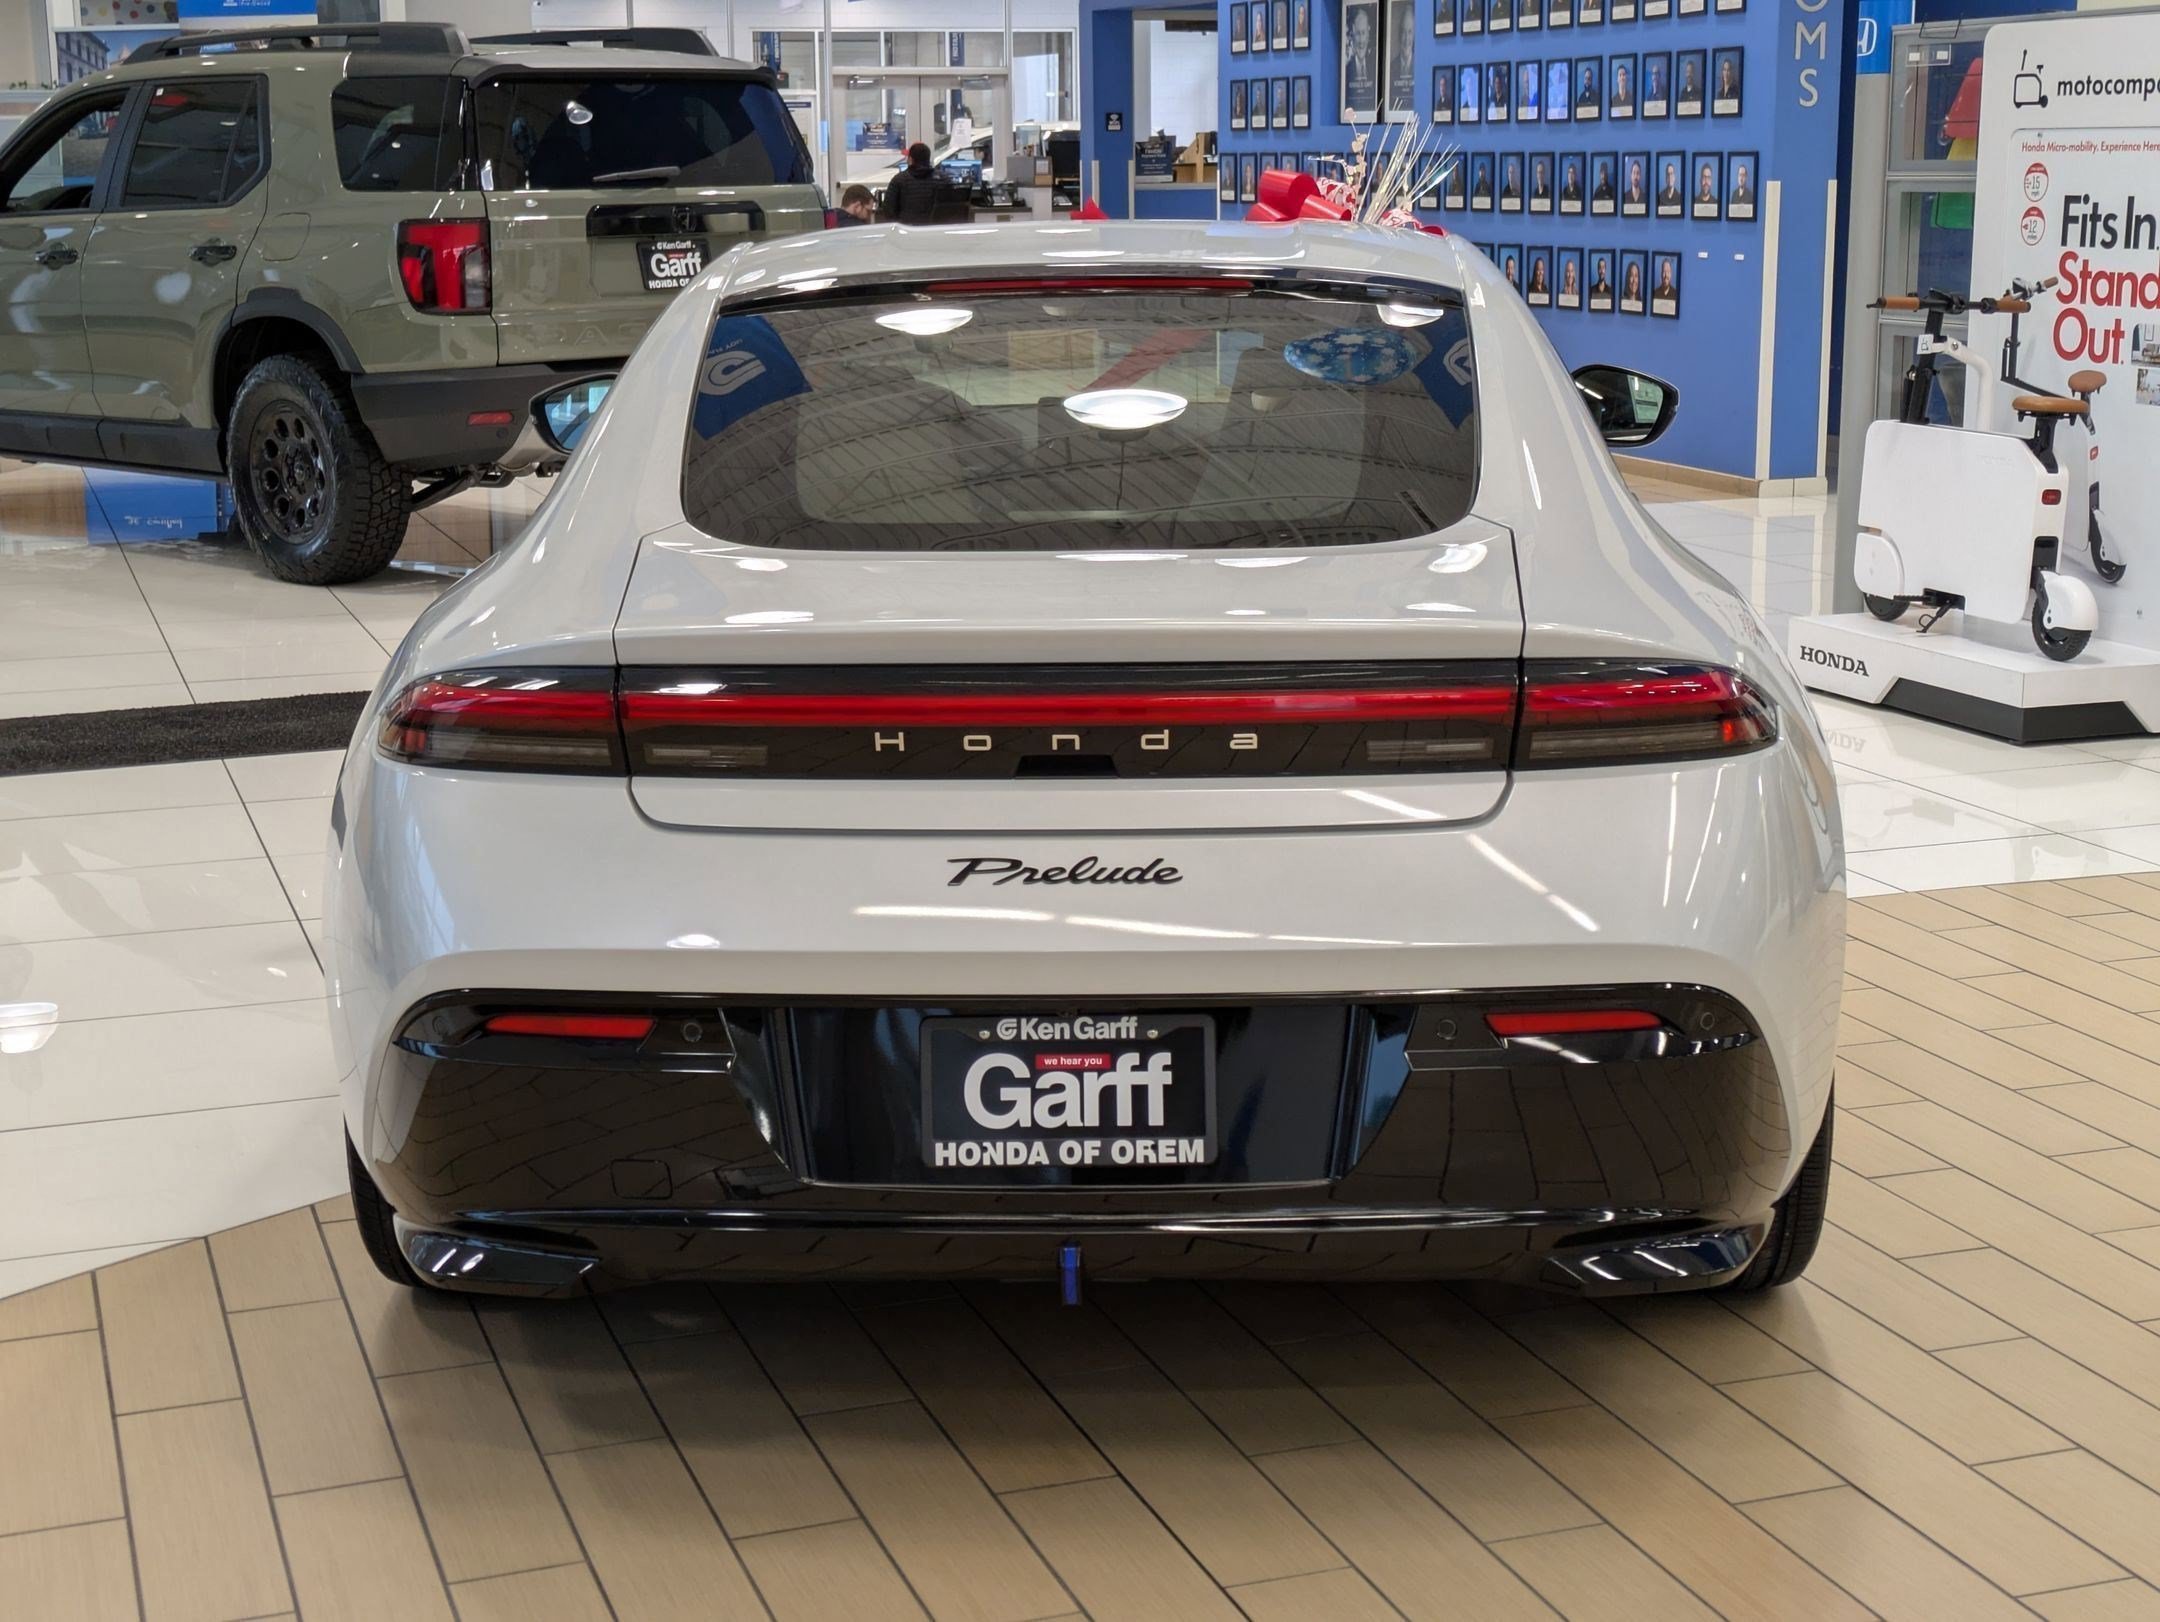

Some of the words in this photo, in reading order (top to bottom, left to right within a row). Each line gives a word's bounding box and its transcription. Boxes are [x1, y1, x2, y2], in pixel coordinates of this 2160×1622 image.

[2022, 142, 2045, 152] Honda
[2032, 175, 2041, 189] 15
[2028, 220, 2038, 233] 12
[2060, 193, 2118, 249] Fits
[2124, 195, 2160, 251] In.
[663, 242, 675, 250] Ken
[650, 252, 702, 278] Garff
[648, 280, 679, 289] HONDA
[2055, 250, 2160, 310] Stand
[2053, 307, 2125, 365] Out.
[1800, 645, 1870, 677] HONDA
[874, 729, 1258, 751] Honda
[947, 856, 1183, 886] Prelude
[1021, 1018, 1070, 1040] Ken
[1074, 1016, 1138, 1039] Garff
[1044, 1058, 1058, 1066] we
[1060, 1056, 1082, 1066] hear
[1084, 1057, 1103, 1068] you
[964, 1052, 1173, 1130] Garff
[935, 1141, 1050, 1167] HONDA
[1059, 1140, 1101, 1165] OF
[1111, 1139, 1204, 1164] OREM
